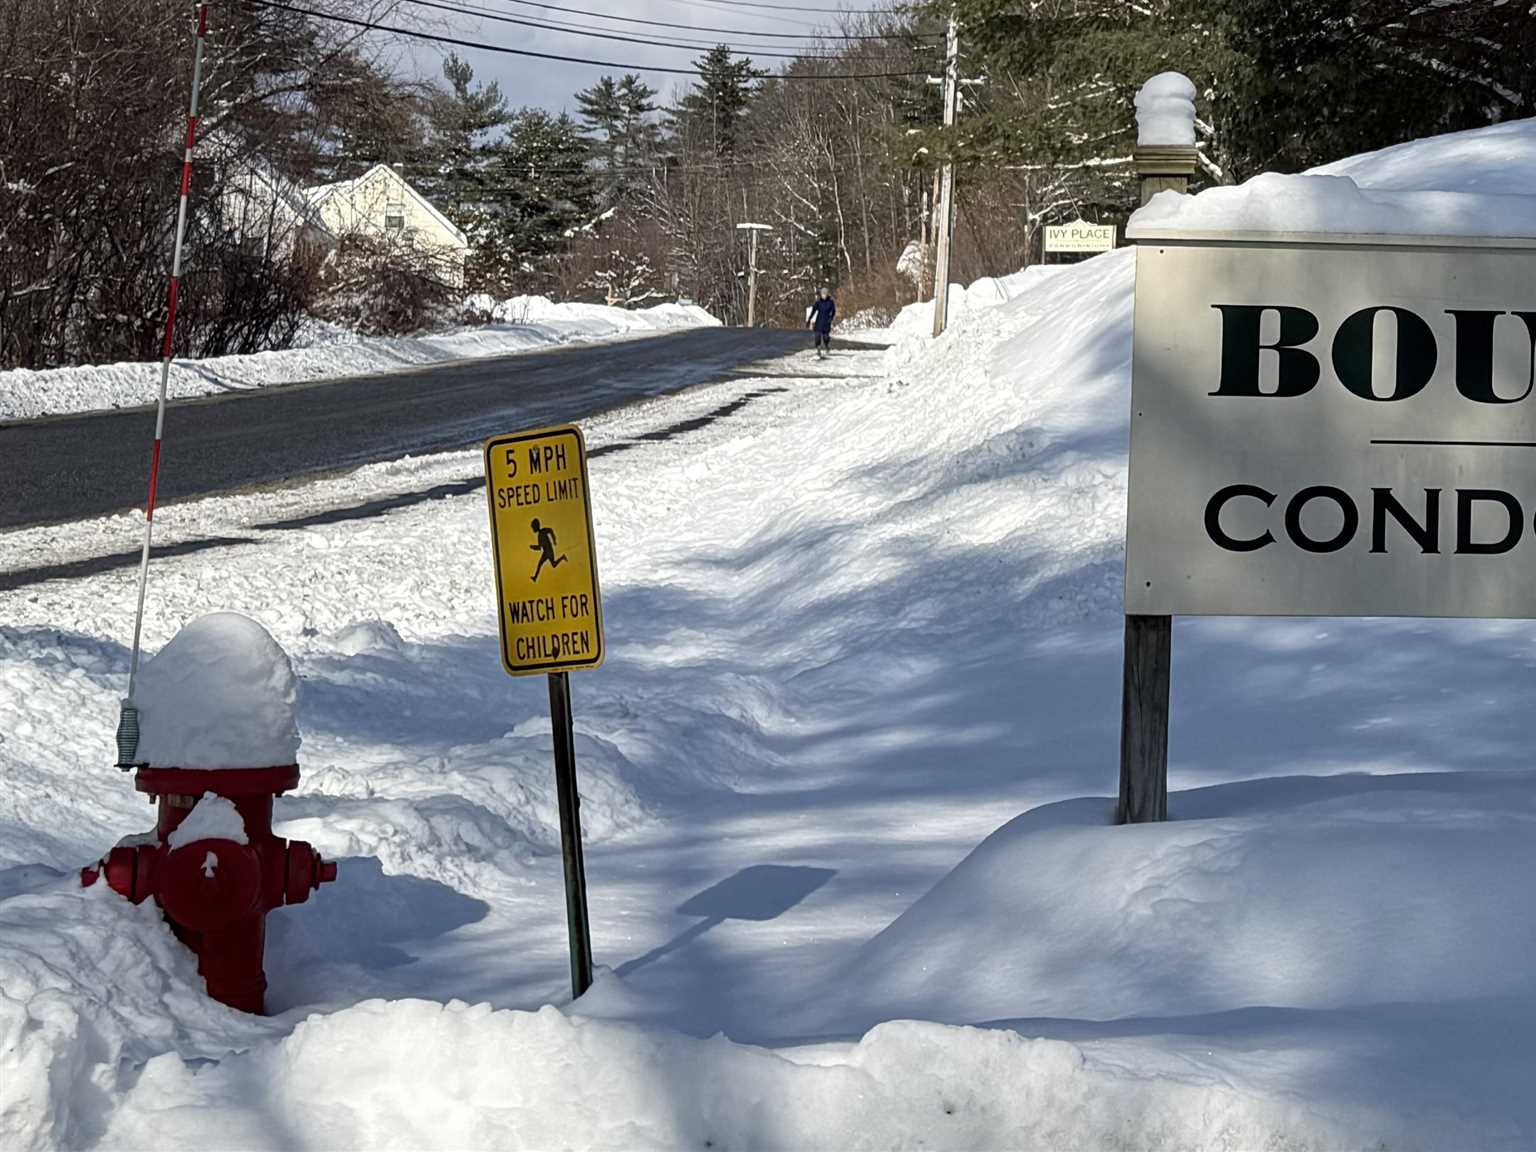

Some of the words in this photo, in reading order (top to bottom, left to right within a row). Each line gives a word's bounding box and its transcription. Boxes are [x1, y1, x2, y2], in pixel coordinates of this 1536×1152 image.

[1050, 229, 1067, 239] IVY
[1072, 229, 1110, 239] PLACE
[506, 449, 517, 478] 5
[529, 444, 567, 475] MPH
[498, 483, 540, 509] SPEED
[545, 477, 580, 502] LIMIT
[508, 598, 556, 625] WATCH
[561, 593, 590, 621] FOR
[516, 630, 591, 660] CHILDREN
